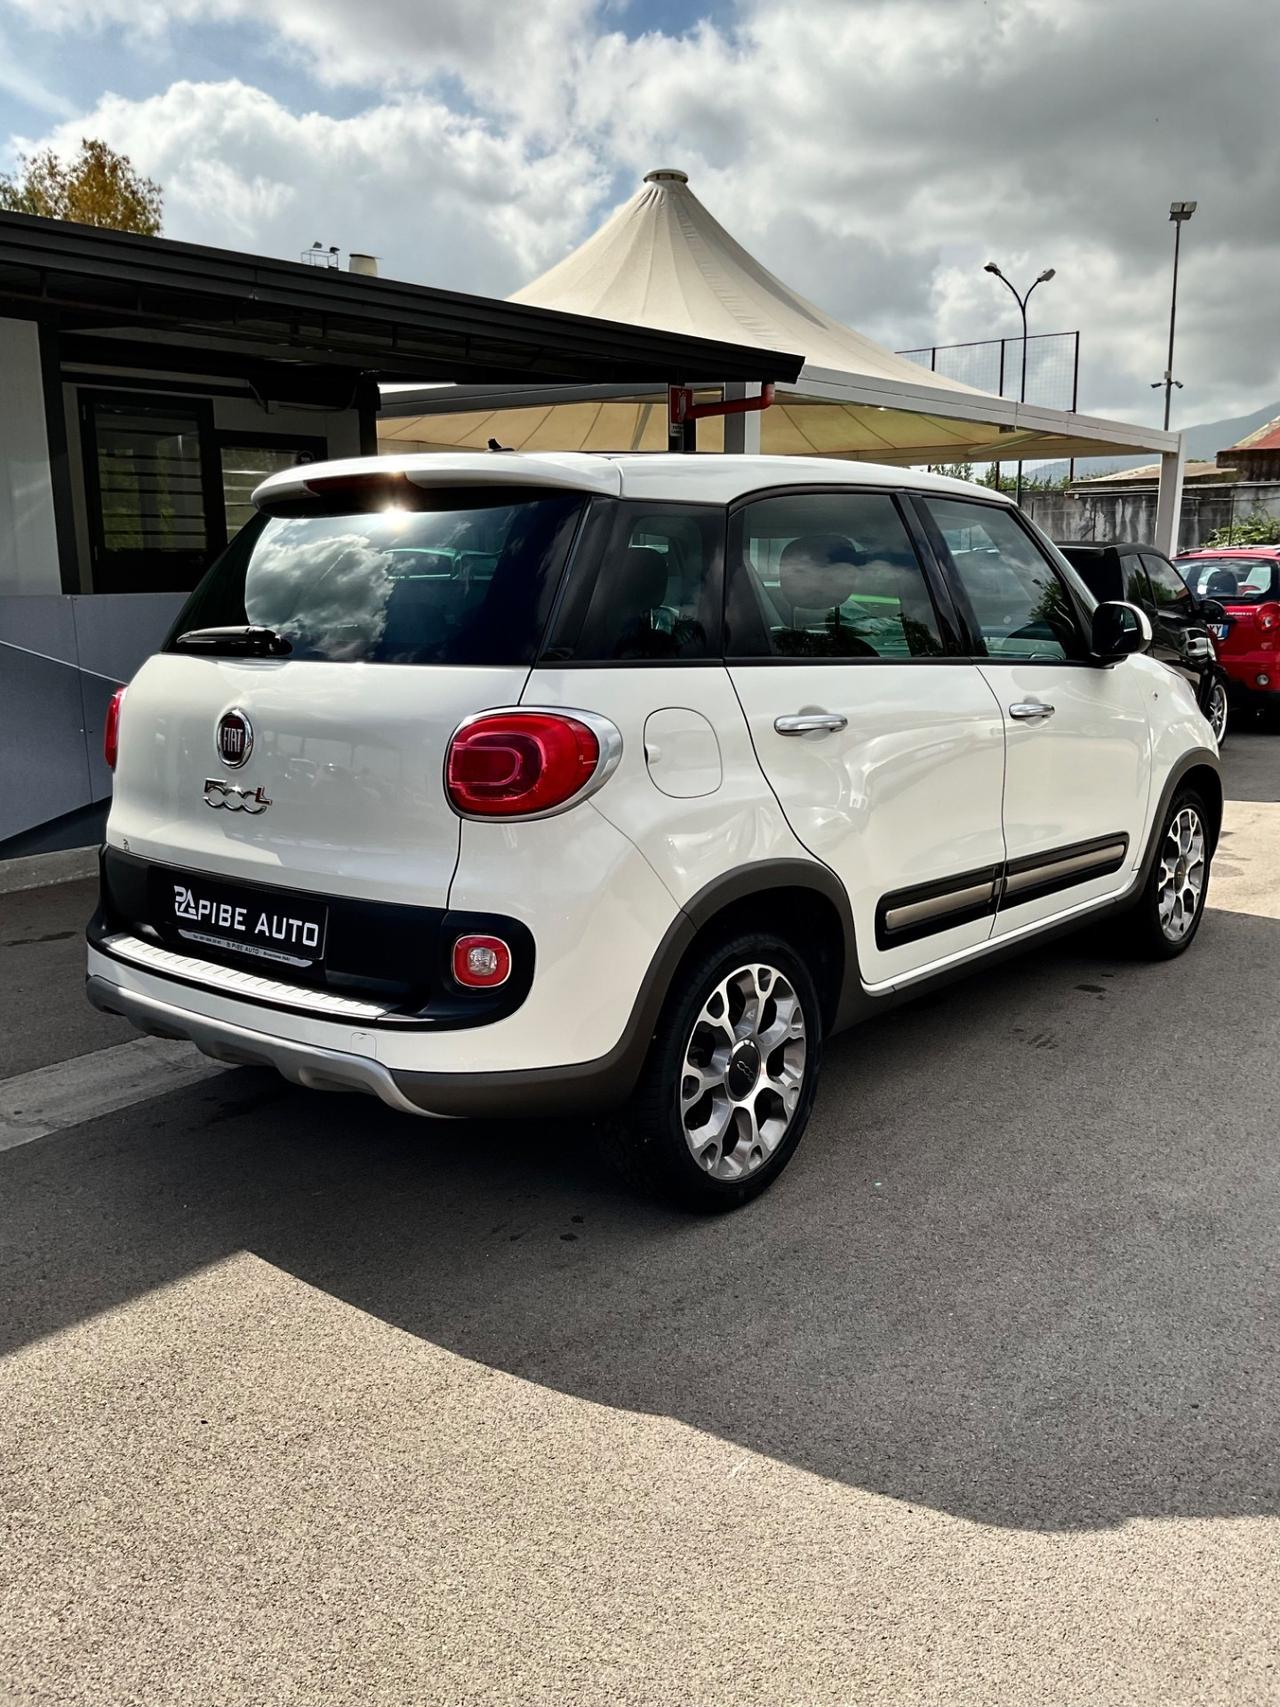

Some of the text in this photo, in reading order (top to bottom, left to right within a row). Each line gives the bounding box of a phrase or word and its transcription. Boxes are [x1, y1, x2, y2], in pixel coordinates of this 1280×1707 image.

[223, 727, 243, 753] FIAT
[198, 899, 247, 931] PIBE
[254, 912, 319, 947] AUTO
